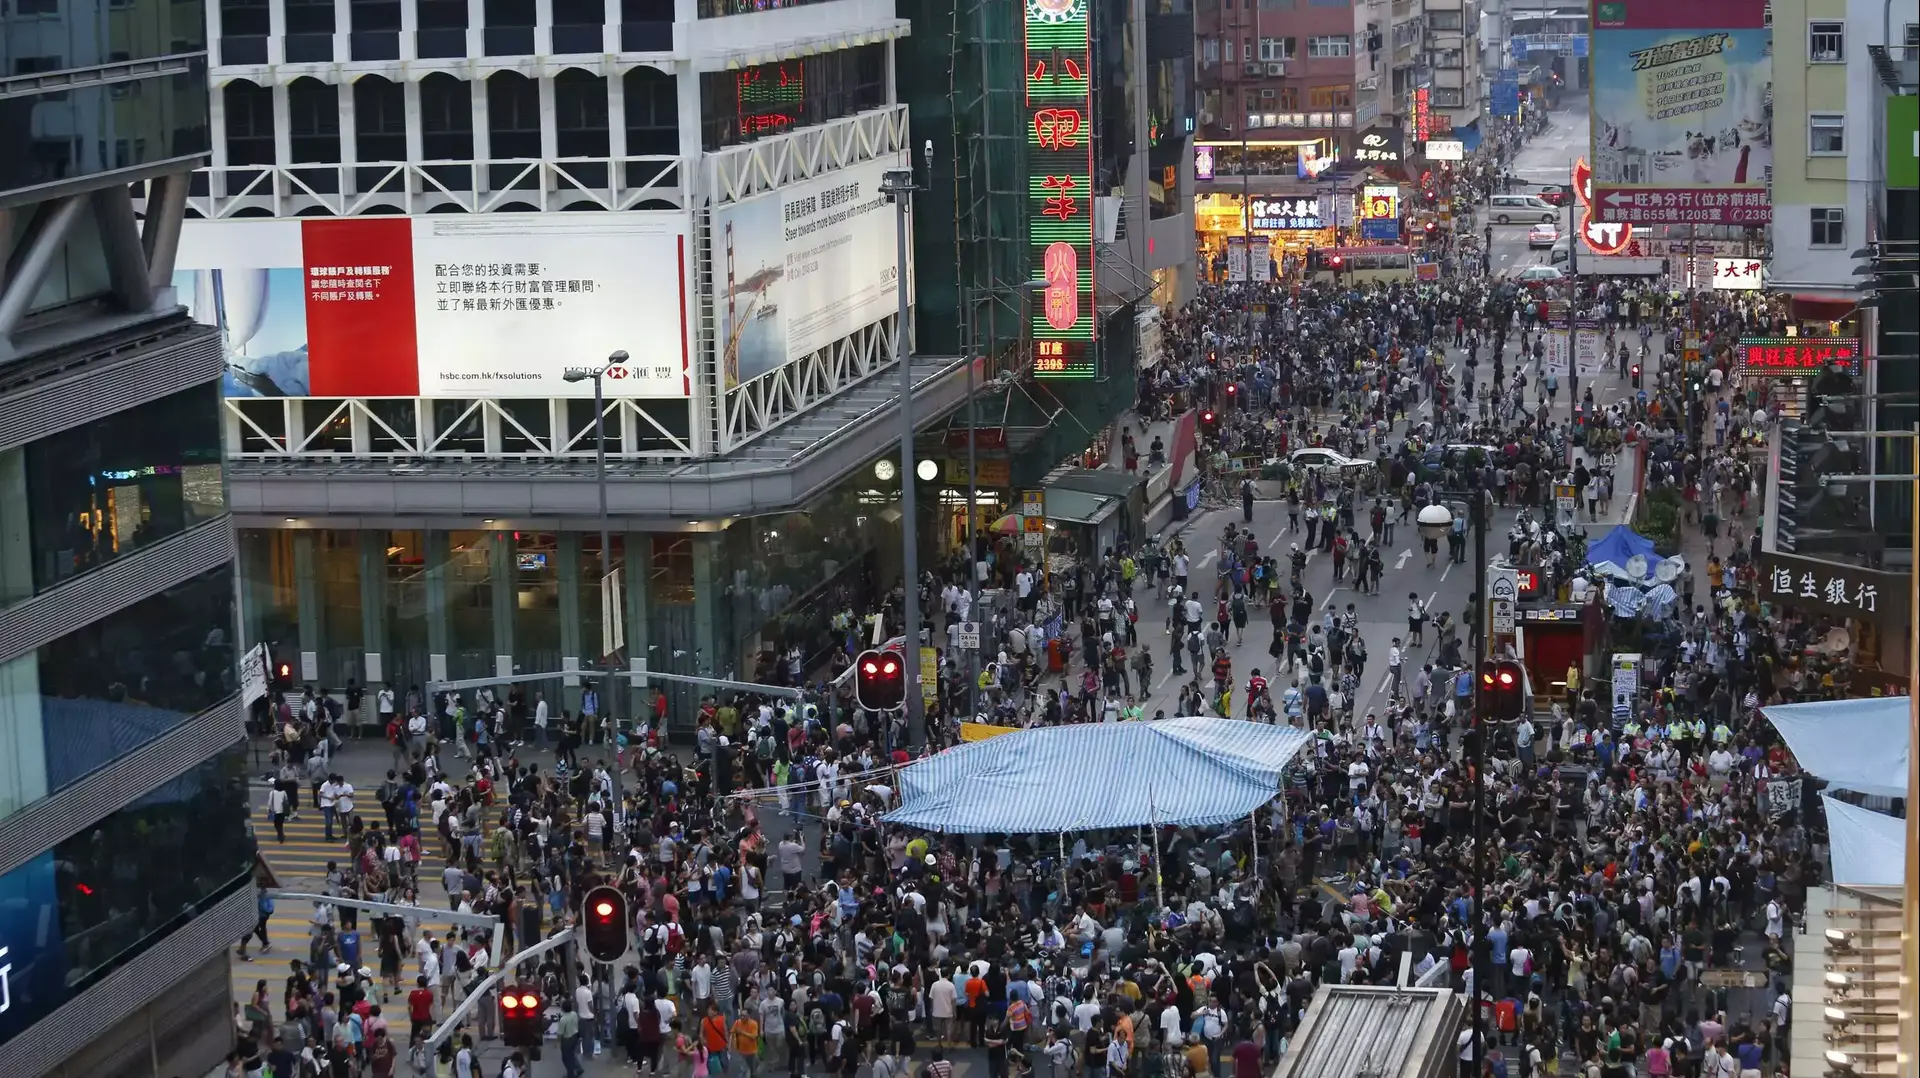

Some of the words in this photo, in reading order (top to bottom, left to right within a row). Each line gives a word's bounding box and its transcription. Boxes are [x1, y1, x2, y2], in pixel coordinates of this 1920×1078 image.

[785, 226, 797, 241] Steer
[798, 218, 815, 236] towards
[816, 216, 828, 230] more
[828, 209, 846, 226] business
[440, 372, 542, 381] hsbc.com.hk/fxsolutions
[1770, 565, 1877, 612] 恒生銀行
